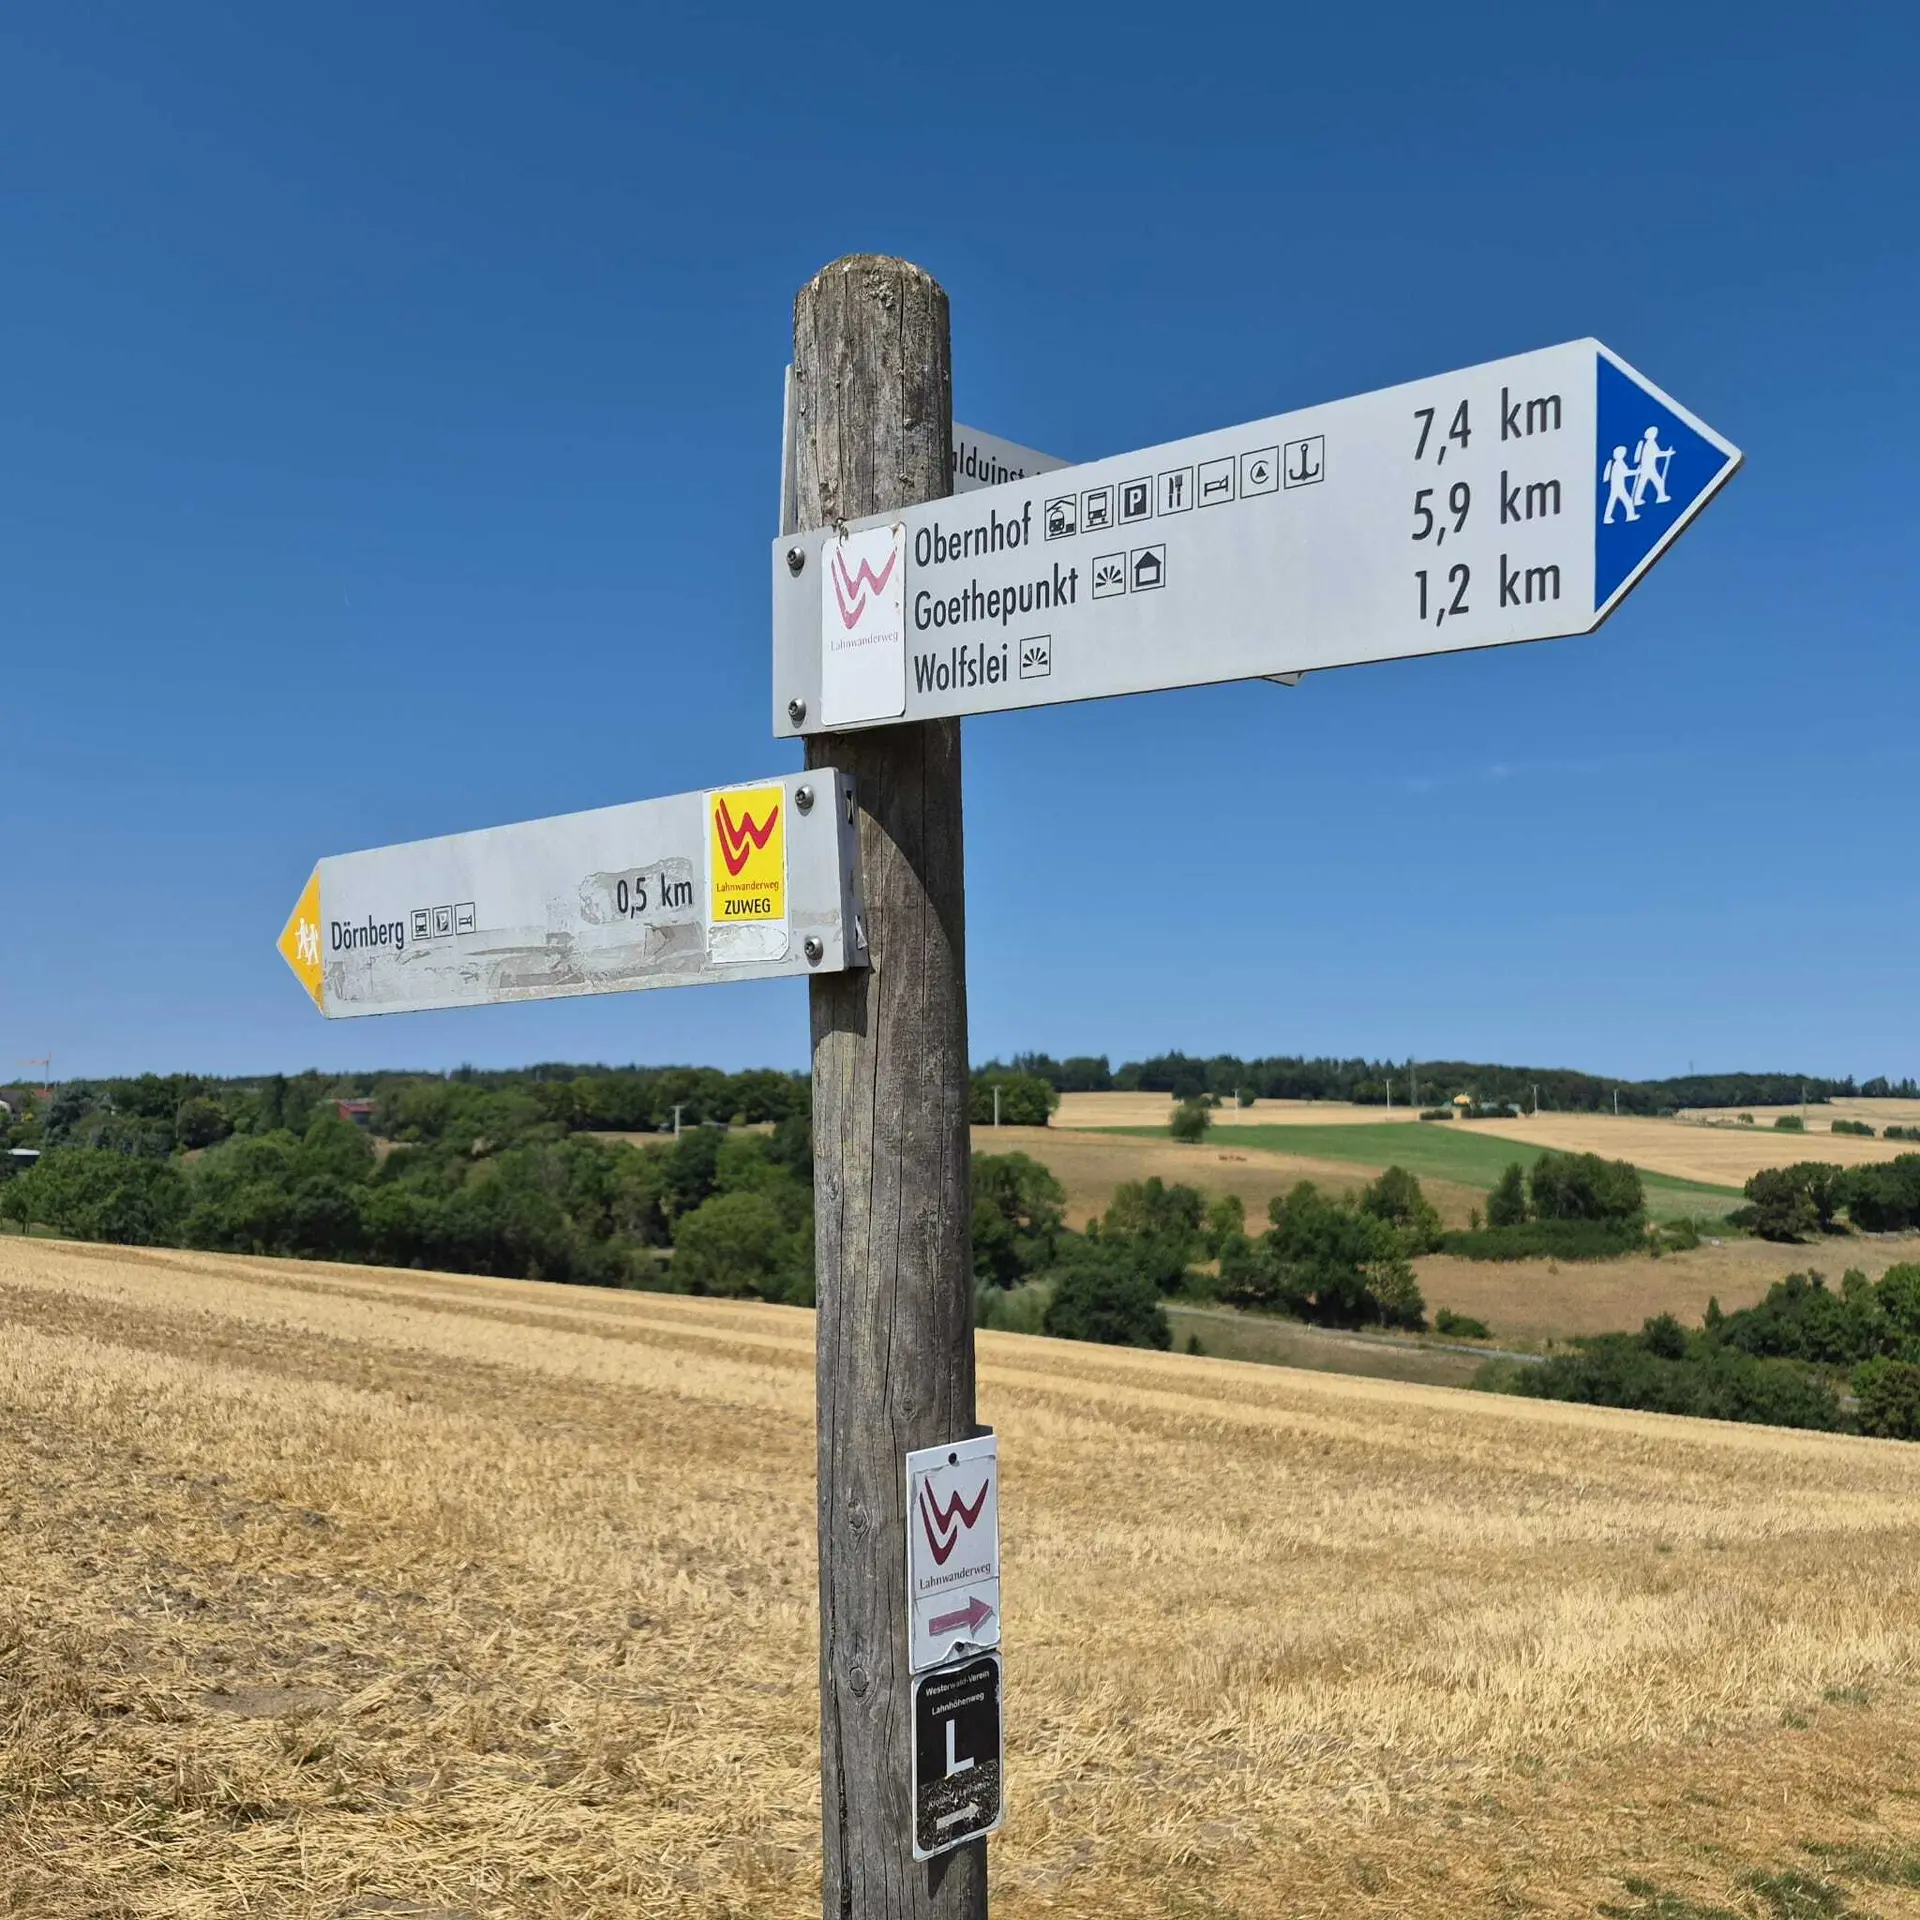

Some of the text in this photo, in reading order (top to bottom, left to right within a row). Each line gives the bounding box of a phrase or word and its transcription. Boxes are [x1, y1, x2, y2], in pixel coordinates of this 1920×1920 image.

[1413, 387, 1562, 466] 7,4 km
[915, 501, 1031, 567] Obernhof
[1412, 470, 1561, 547] 5,9 km
[914, 562, 1078, 631] Goethepunkt
[1414, 553, 1560, 627] 1,2 km
[830, 631, 898, 652] Lahnwanderweg
[914, 643, 1008, 694] Wolfslei
[617, 872, 693, 919] 0,5 km
[716, 879, 779, 893] Lahnwanderweg
[724, 898, 771, 915] ZUWEG
[331, 914, 405, 951] Dörnberg
[919, 1562, 991, 1591] Lahnwanderweg
[945, 1719, 975, 1780] L
